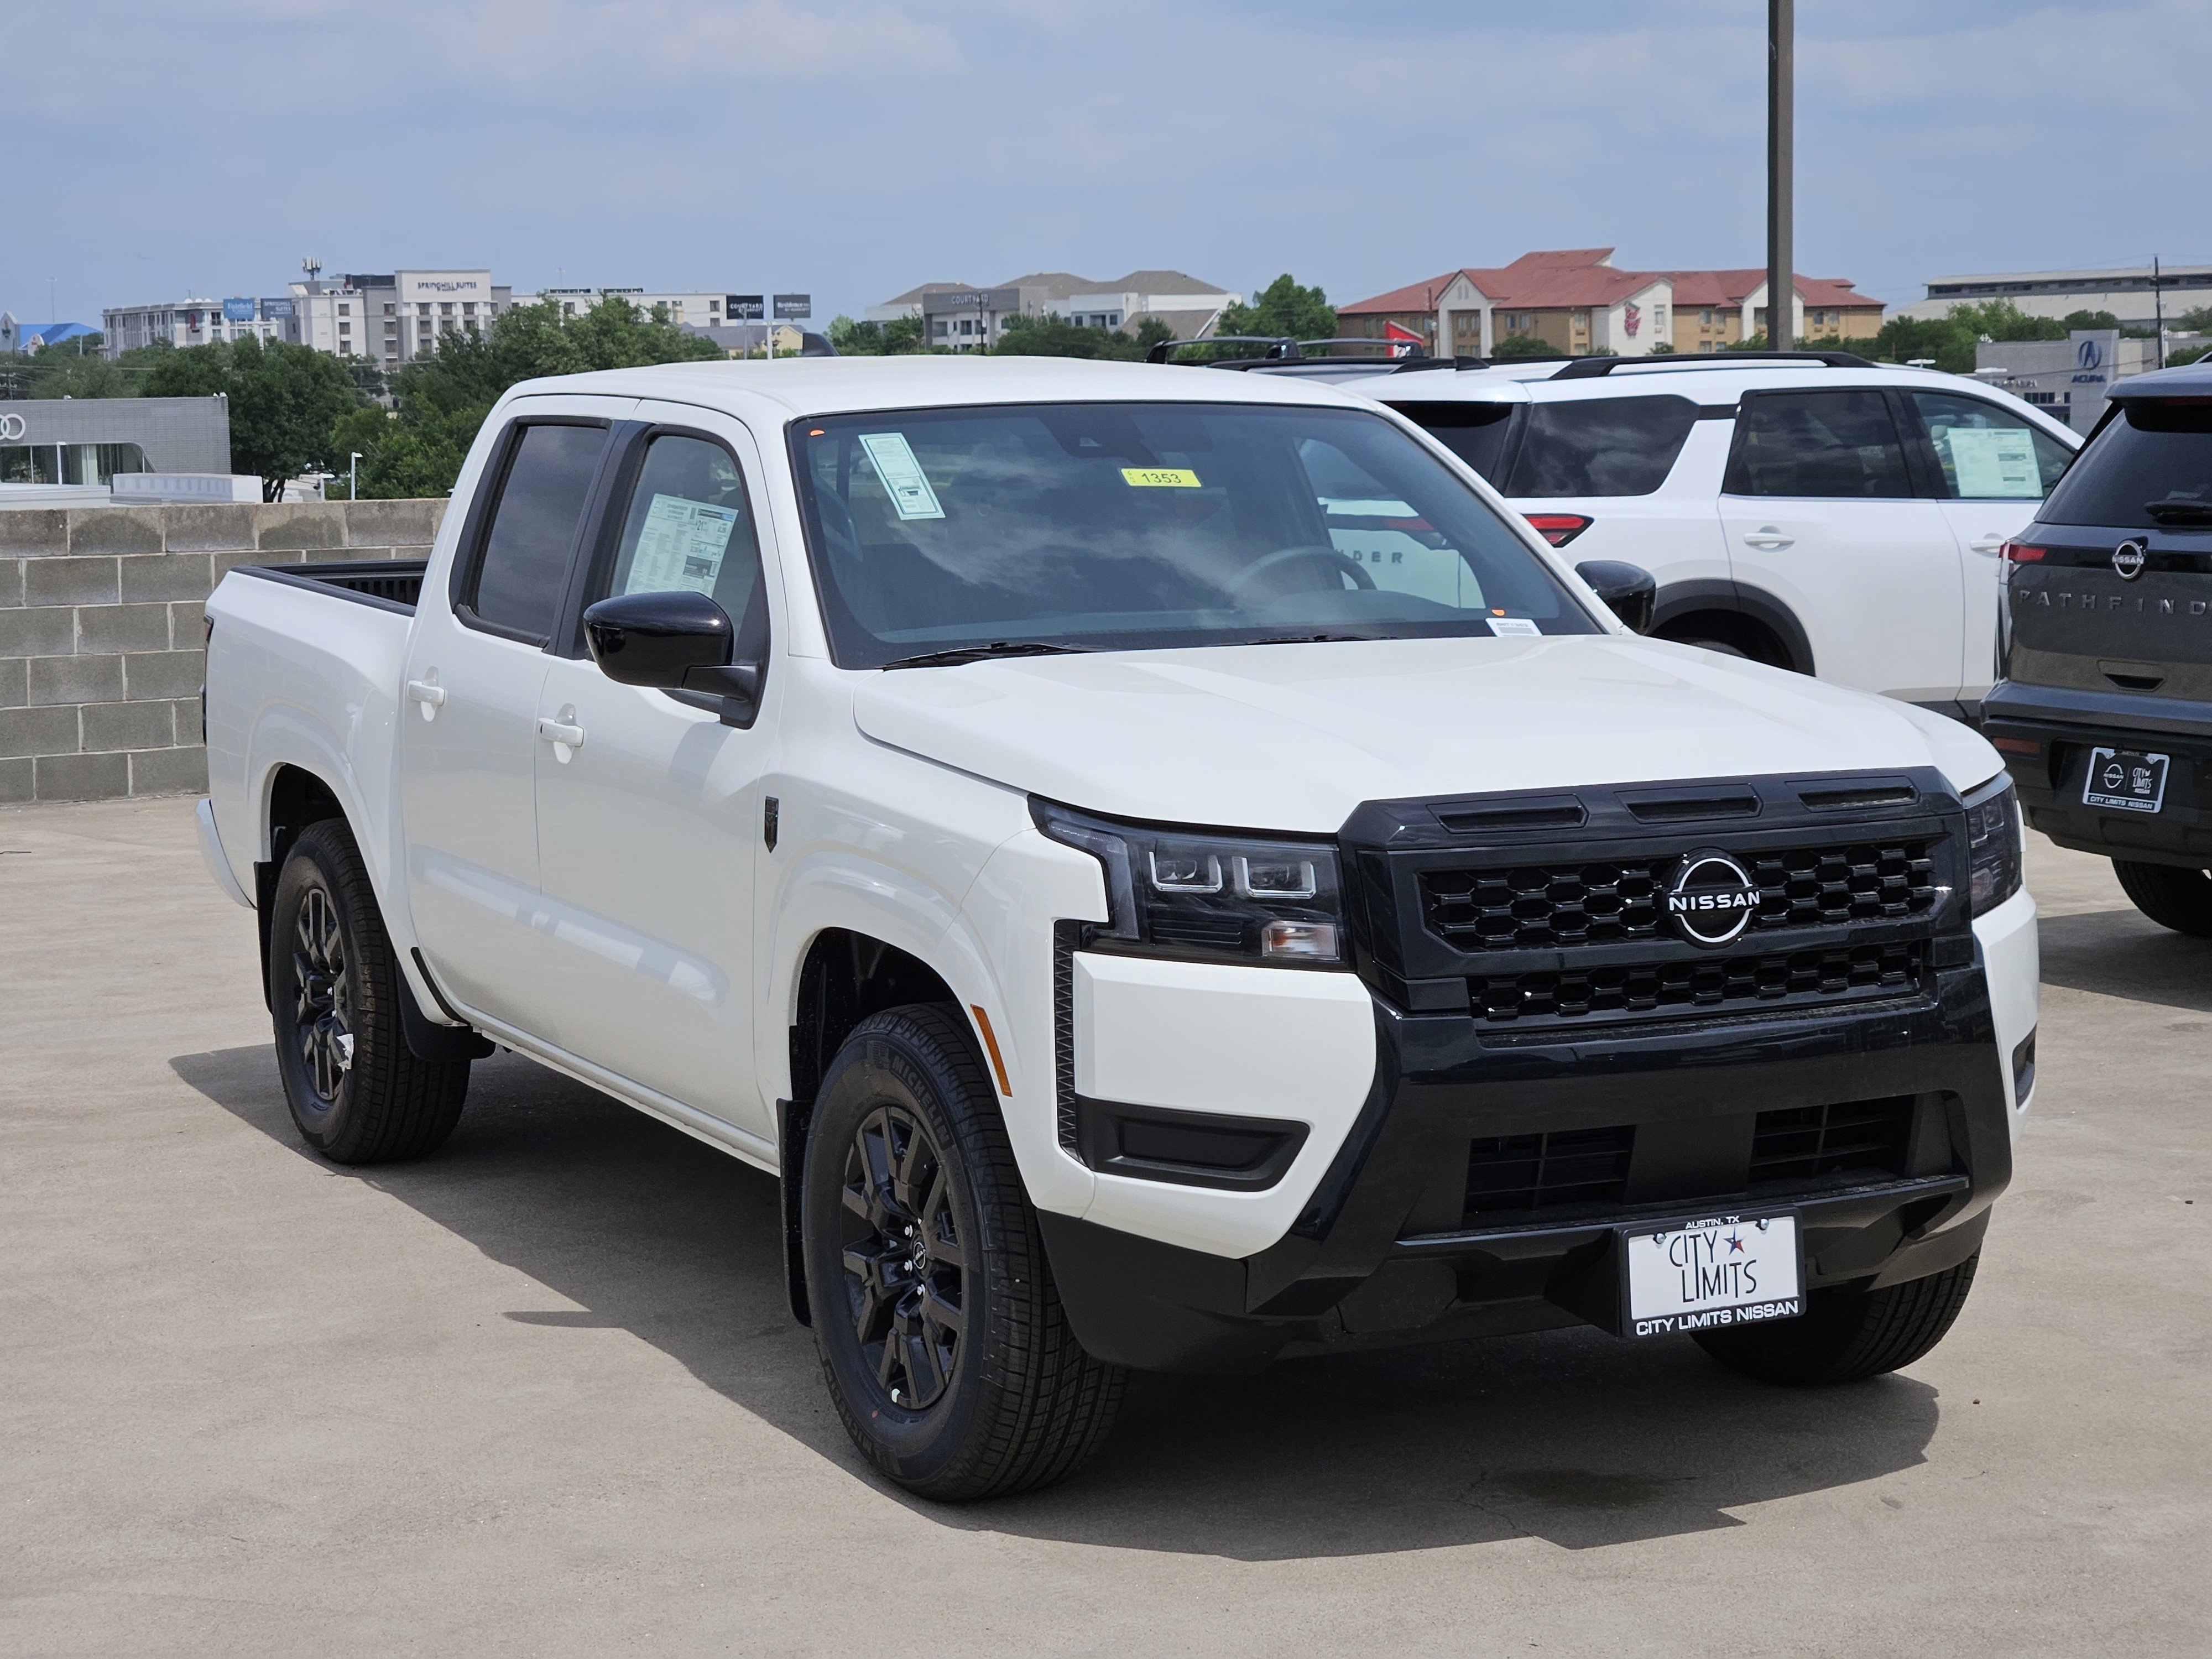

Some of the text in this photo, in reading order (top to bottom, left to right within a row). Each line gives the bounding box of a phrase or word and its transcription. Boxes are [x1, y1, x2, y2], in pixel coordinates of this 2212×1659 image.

[2071, 374, 2106, 383] ACURA
[1141, 473, 1181, 483] 1353
[2111, 555, 2145, 565] NISSAN
[2018, 589, 2212, 615] PATHFIND
[2105, 798, 2126, 806] LIMITS
[2127, 801, 2153, 810] NISSAN
[1668, 891, 1760, 911] NISSAN
[891, 1043, 951, 1144] MICHELIN
[1686, 1215, 1740, 1229] AUSTIN, TX
[1669, 1229, 1718, 1275] CITY
[1681, 1259, 1757, 1303] LIMITS
[1636, 1300, 1799, 1336] CITY LIMITS NISSAN
